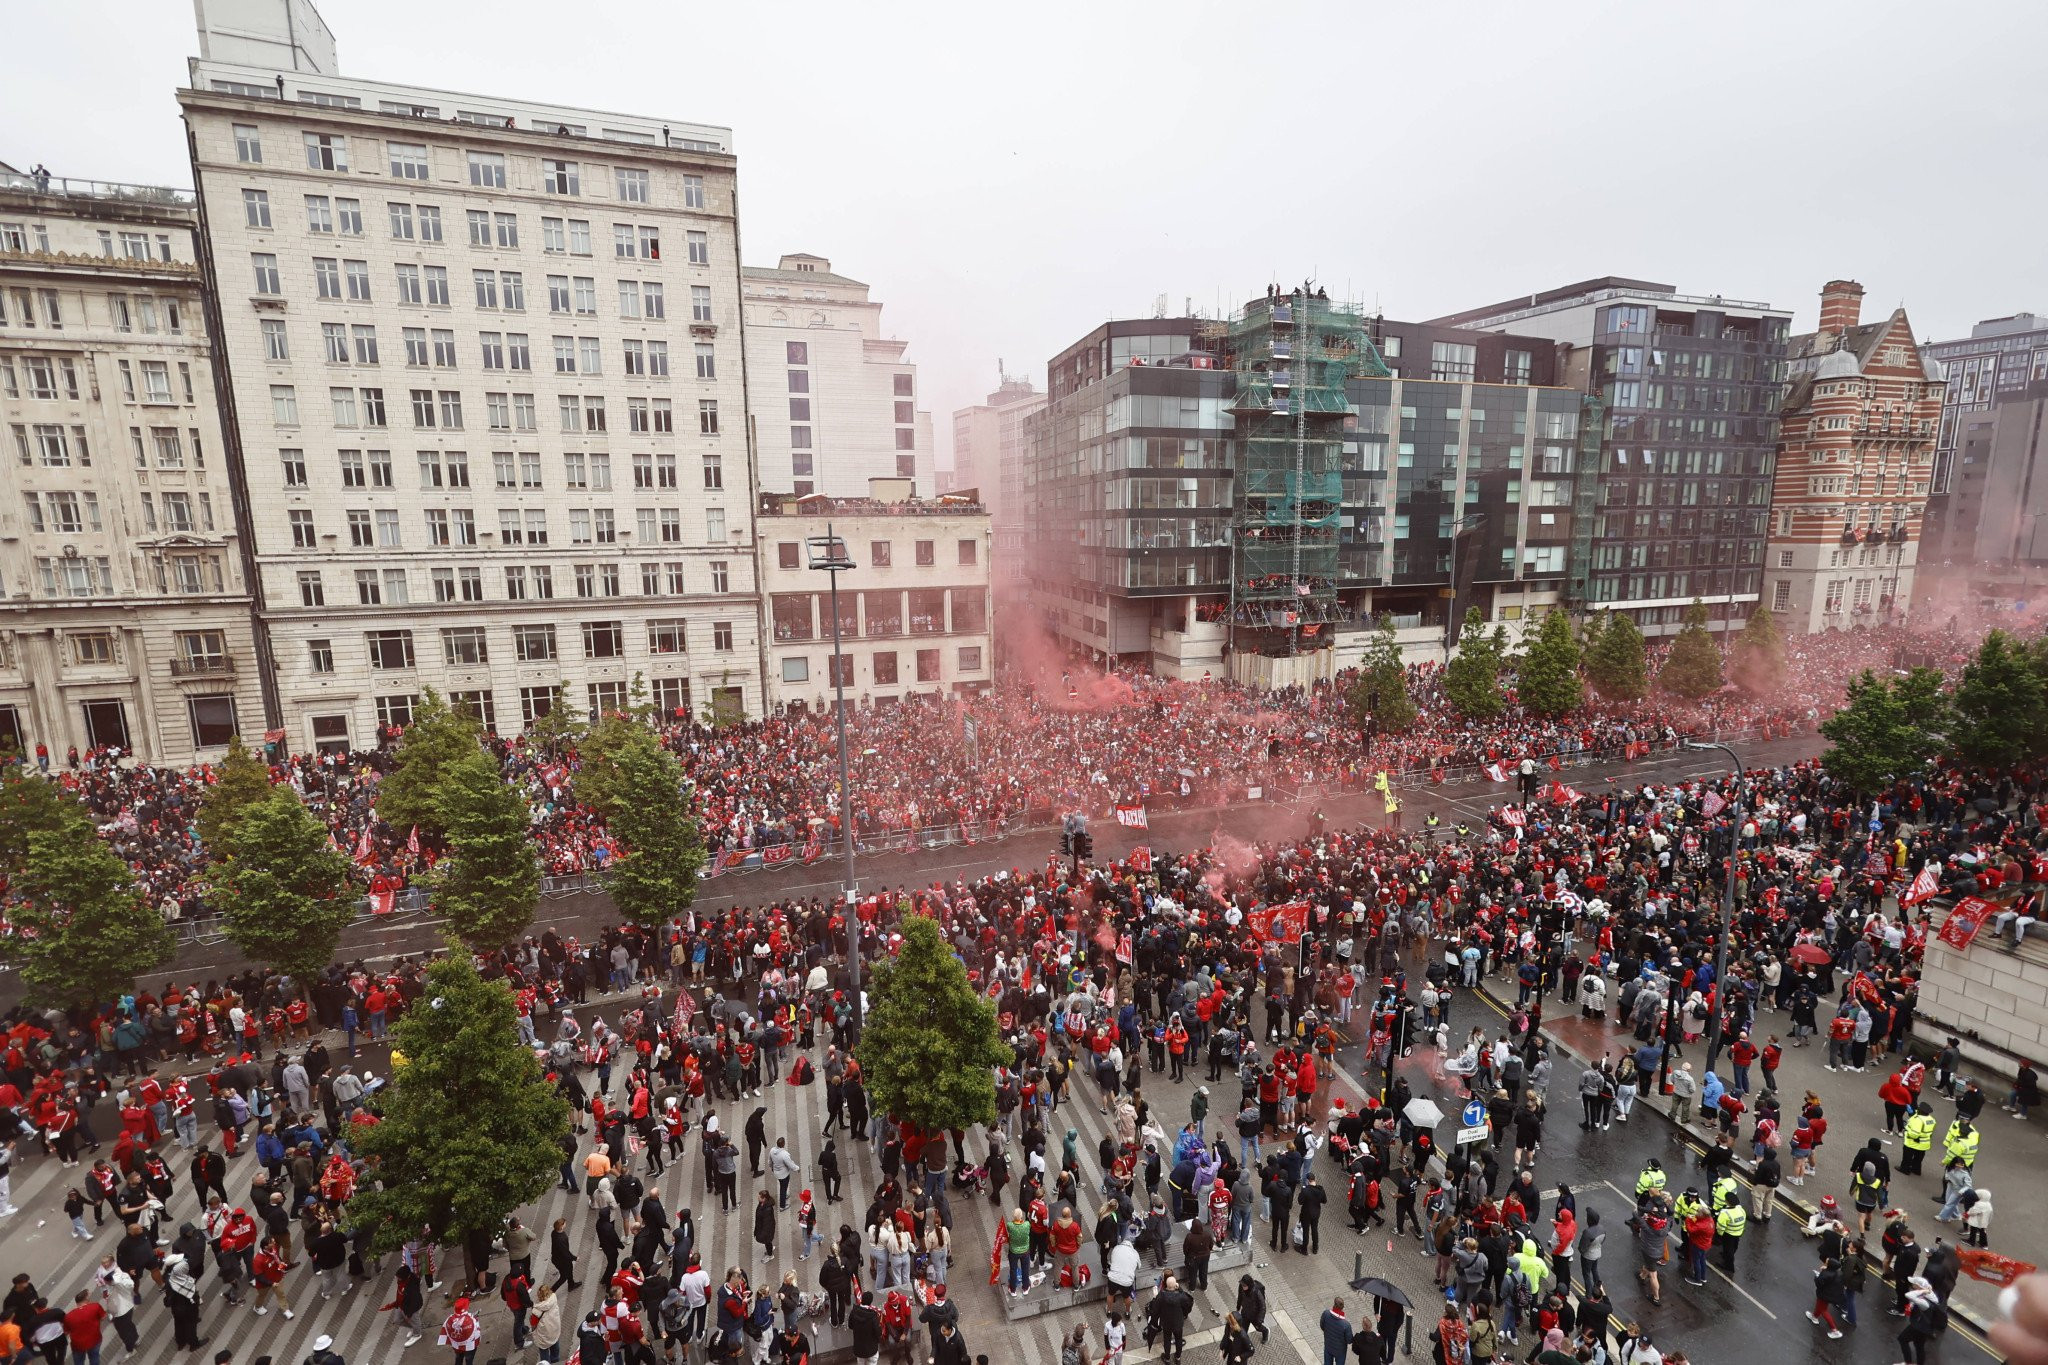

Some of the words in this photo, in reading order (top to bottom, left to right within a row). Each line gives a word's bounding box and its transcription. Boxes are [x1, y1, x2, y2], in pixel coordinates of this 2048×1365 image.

[885, 894, 890, 904] 5
[1459, 1133, 1486, 1142] carriageway
[1031, 1210, 1038, 1224] 4
